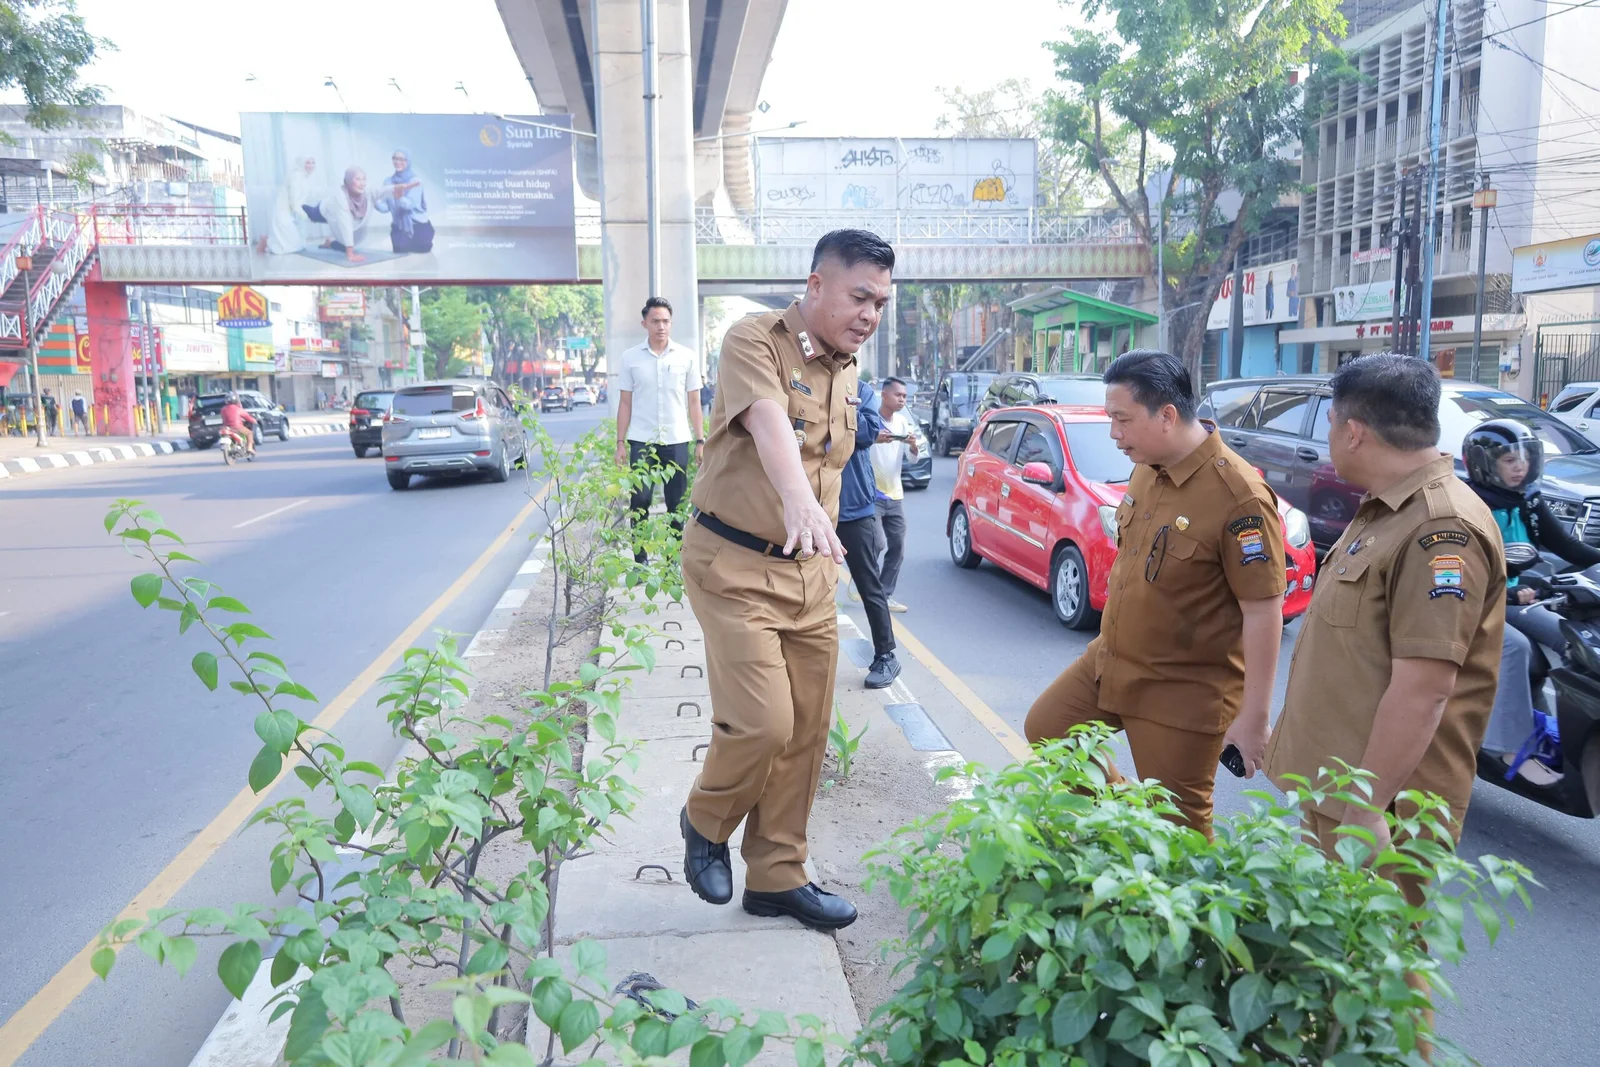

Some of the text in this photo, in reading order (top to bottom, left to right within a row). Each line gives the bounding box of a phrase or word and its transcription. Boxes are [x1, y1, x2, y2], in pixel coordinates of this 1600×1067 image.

[505, 125, 533, 139] Sun
[506, 140, 533, 149] Syariah
[444, 178, 551, 190] Mending yang buat hidup
[445, 189, 555, 200] sehatmu makin bermakna.
[220, 286, 264, 320] MS
[1370, 326, 1380, 336] PT
